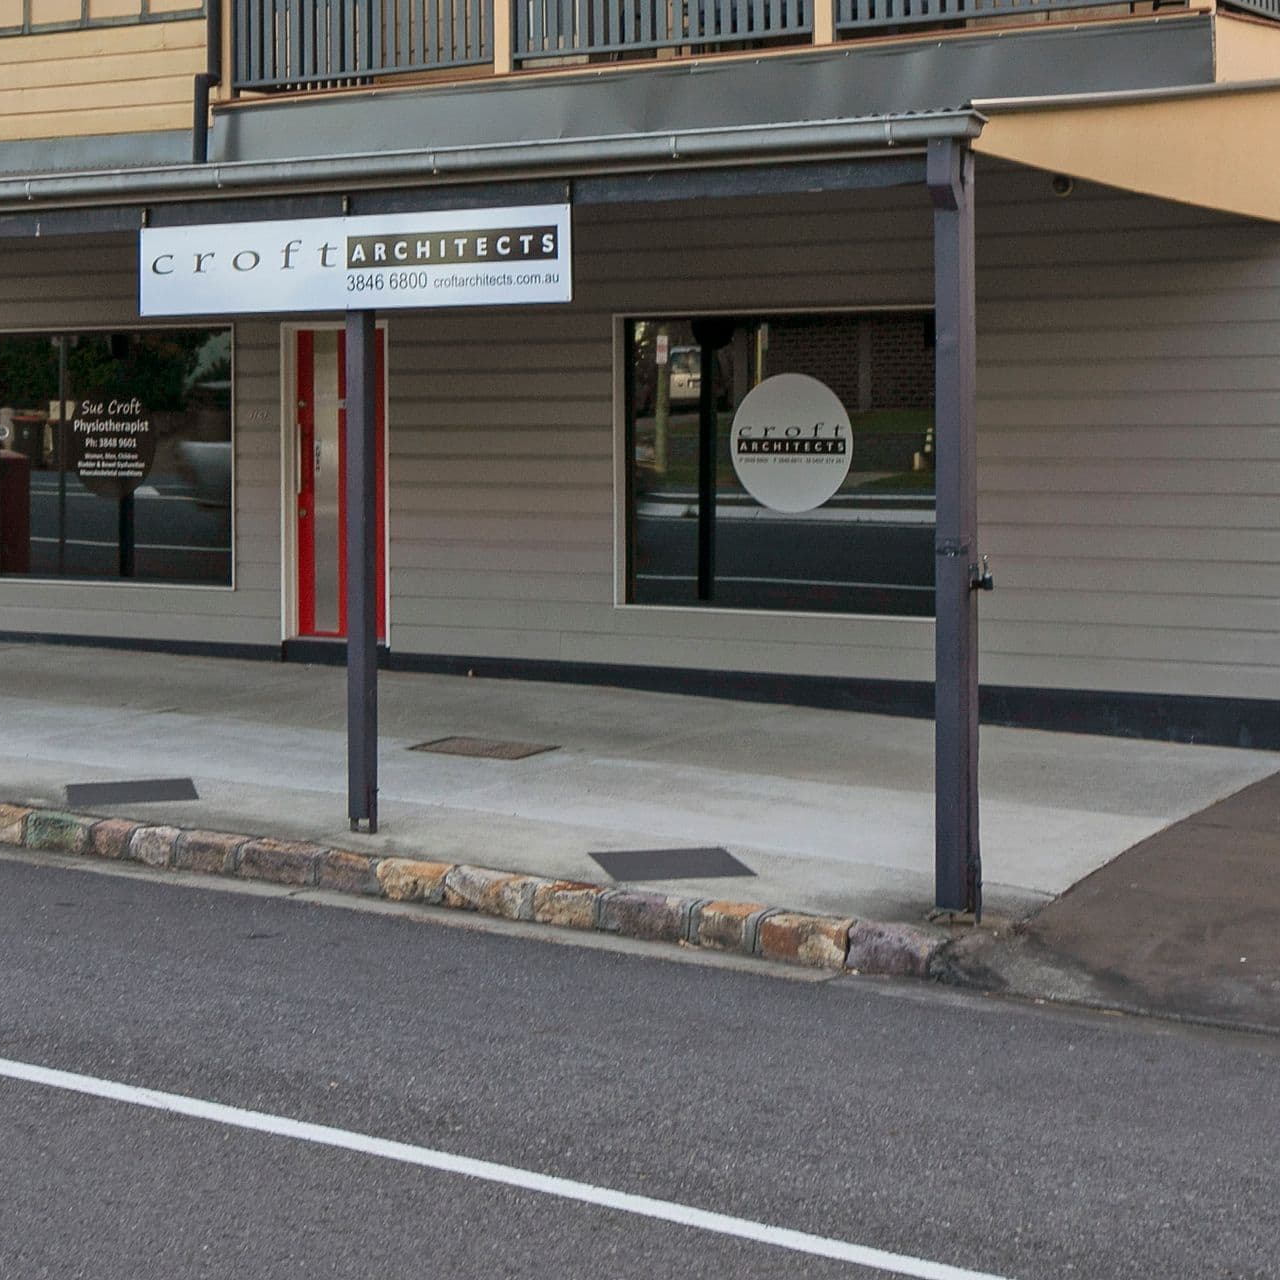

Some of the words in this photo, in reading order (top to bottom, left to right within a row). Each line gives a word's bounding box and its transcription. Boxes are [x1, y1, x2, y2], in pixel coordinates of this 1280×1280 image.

[151, 239, 338, 275] croft
[351, 233, 555, 263] ARCHITECTS
[346, 273, 385, 292] 3846
[389, 271, 428, 290] 6800
[433, 272, 560, 289] croftarchitects.com.au
[81, 400, 104, 415] Sue
[108, 397, 141, 415] Croft
[73, 418, 149, 434] Physiotherapist
[738, 421, 844, 438] croft
[740, 442, 844, 452] ARCHITECTS
